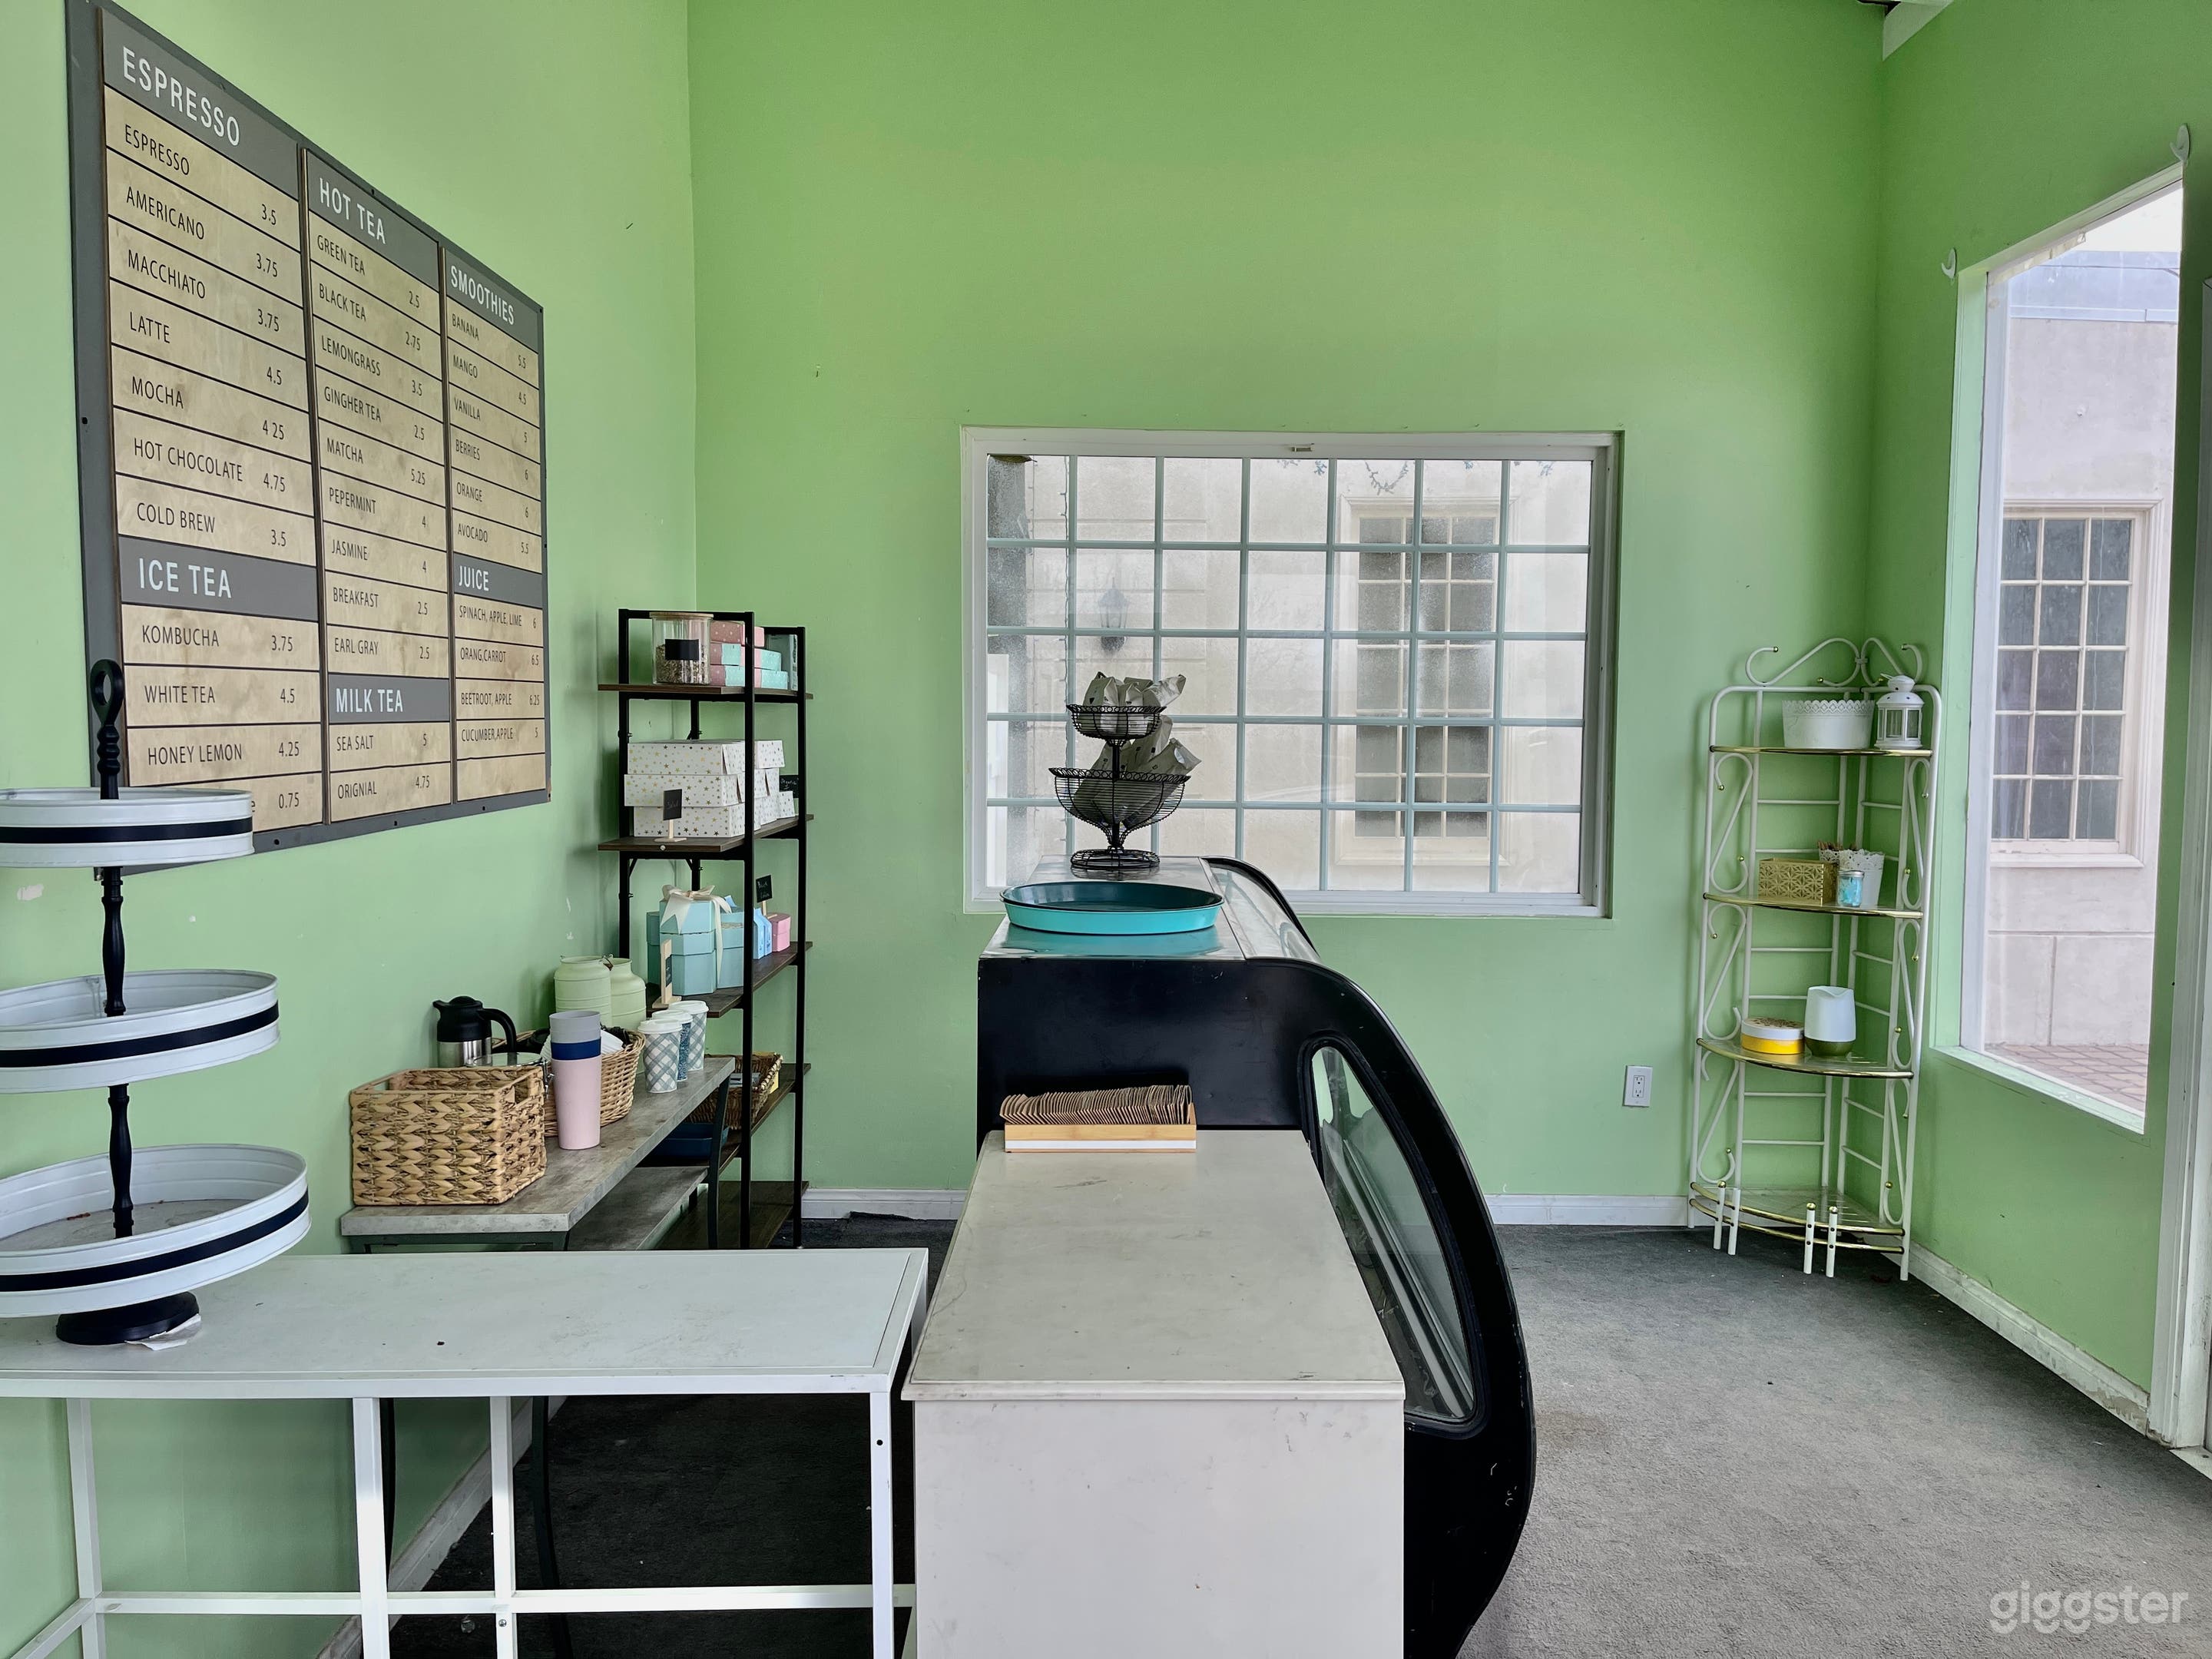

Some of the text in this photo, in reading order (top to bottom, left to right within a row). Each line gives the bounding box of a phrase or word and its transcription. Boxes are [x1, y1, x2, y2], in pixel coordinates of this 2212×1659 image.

[123, 46, 240, 146] ESPRESSO
[125, 124, 276, 226] ESPRESSO 3.5
[320, 177, 386, 244] HOT TEA
[127, 186, 278, 278] AMERICANO 3.75
[127, 250, 280, 332] MACCHIATO 3.75
[317, 234, 419, 309] GREEN TEA 2.5
[450, 265, 515, 326] SMOOTHIES
[319, 283, 421, 351] BLACK TEA 2.75
[130, 312, 282, 386] LATTE 4.5
[452, 313, 527, 369] BANANA 5.5
[321, 335, 422, 396] LEMONGRASS 3.5
[453, 354, 527, 406] MANGO 4.5
[131, 376, 184, 409] MOCHA
[324, 386, 425, 441] GINGHER TEA 2.5
[454, 396, 528, 443] VANILLA 5
[134, 438, 286, 492] HOT CHOCOLATE 4.75
[326, 438, 426, 485] MATCHA 5.25
[455, 439, 528, 481] BERRIES 6
[329, 487, 426, 528] PEPERMINT 4
[456, 482, 528, 518] ORANGE 6
[137, 502, 286, 547] COLD BREW 3.5
[457, 522, 529, 555] AVOCADO 5.5
[331, 539, 427, 573] JASMINE 4
[138, 558, 232, 598] ICE TEA
[459, 565, 489, 591] JUICE
[333, 587, 428, 616] BREAKFAST 2.5
[459, 605, 536, 629] SPINACH, APPLE, LIME 6
[142, 624, 293, 652] KOMBUCHA 3.75
[334, 638, 430, 660] EARL GRAY 2.5
[531, 654, 539, 666] 6.5
[144, 685, 295, 704] WHITE TEA 4.5
[336, 688, 403, 713] MILK TEA
[461, 692, 540, 707] BEETROOT, APPLE 6.25
[336, 733, 427, 751] SEA SALT 5
[535, 727, 538, 738] 5
[147, 741, 300, 765] HONEY LEMON 4.25
[278, 792, 300, 810] 0.75
[337, 775, 430, 799] ORIGNIAL 4.75
